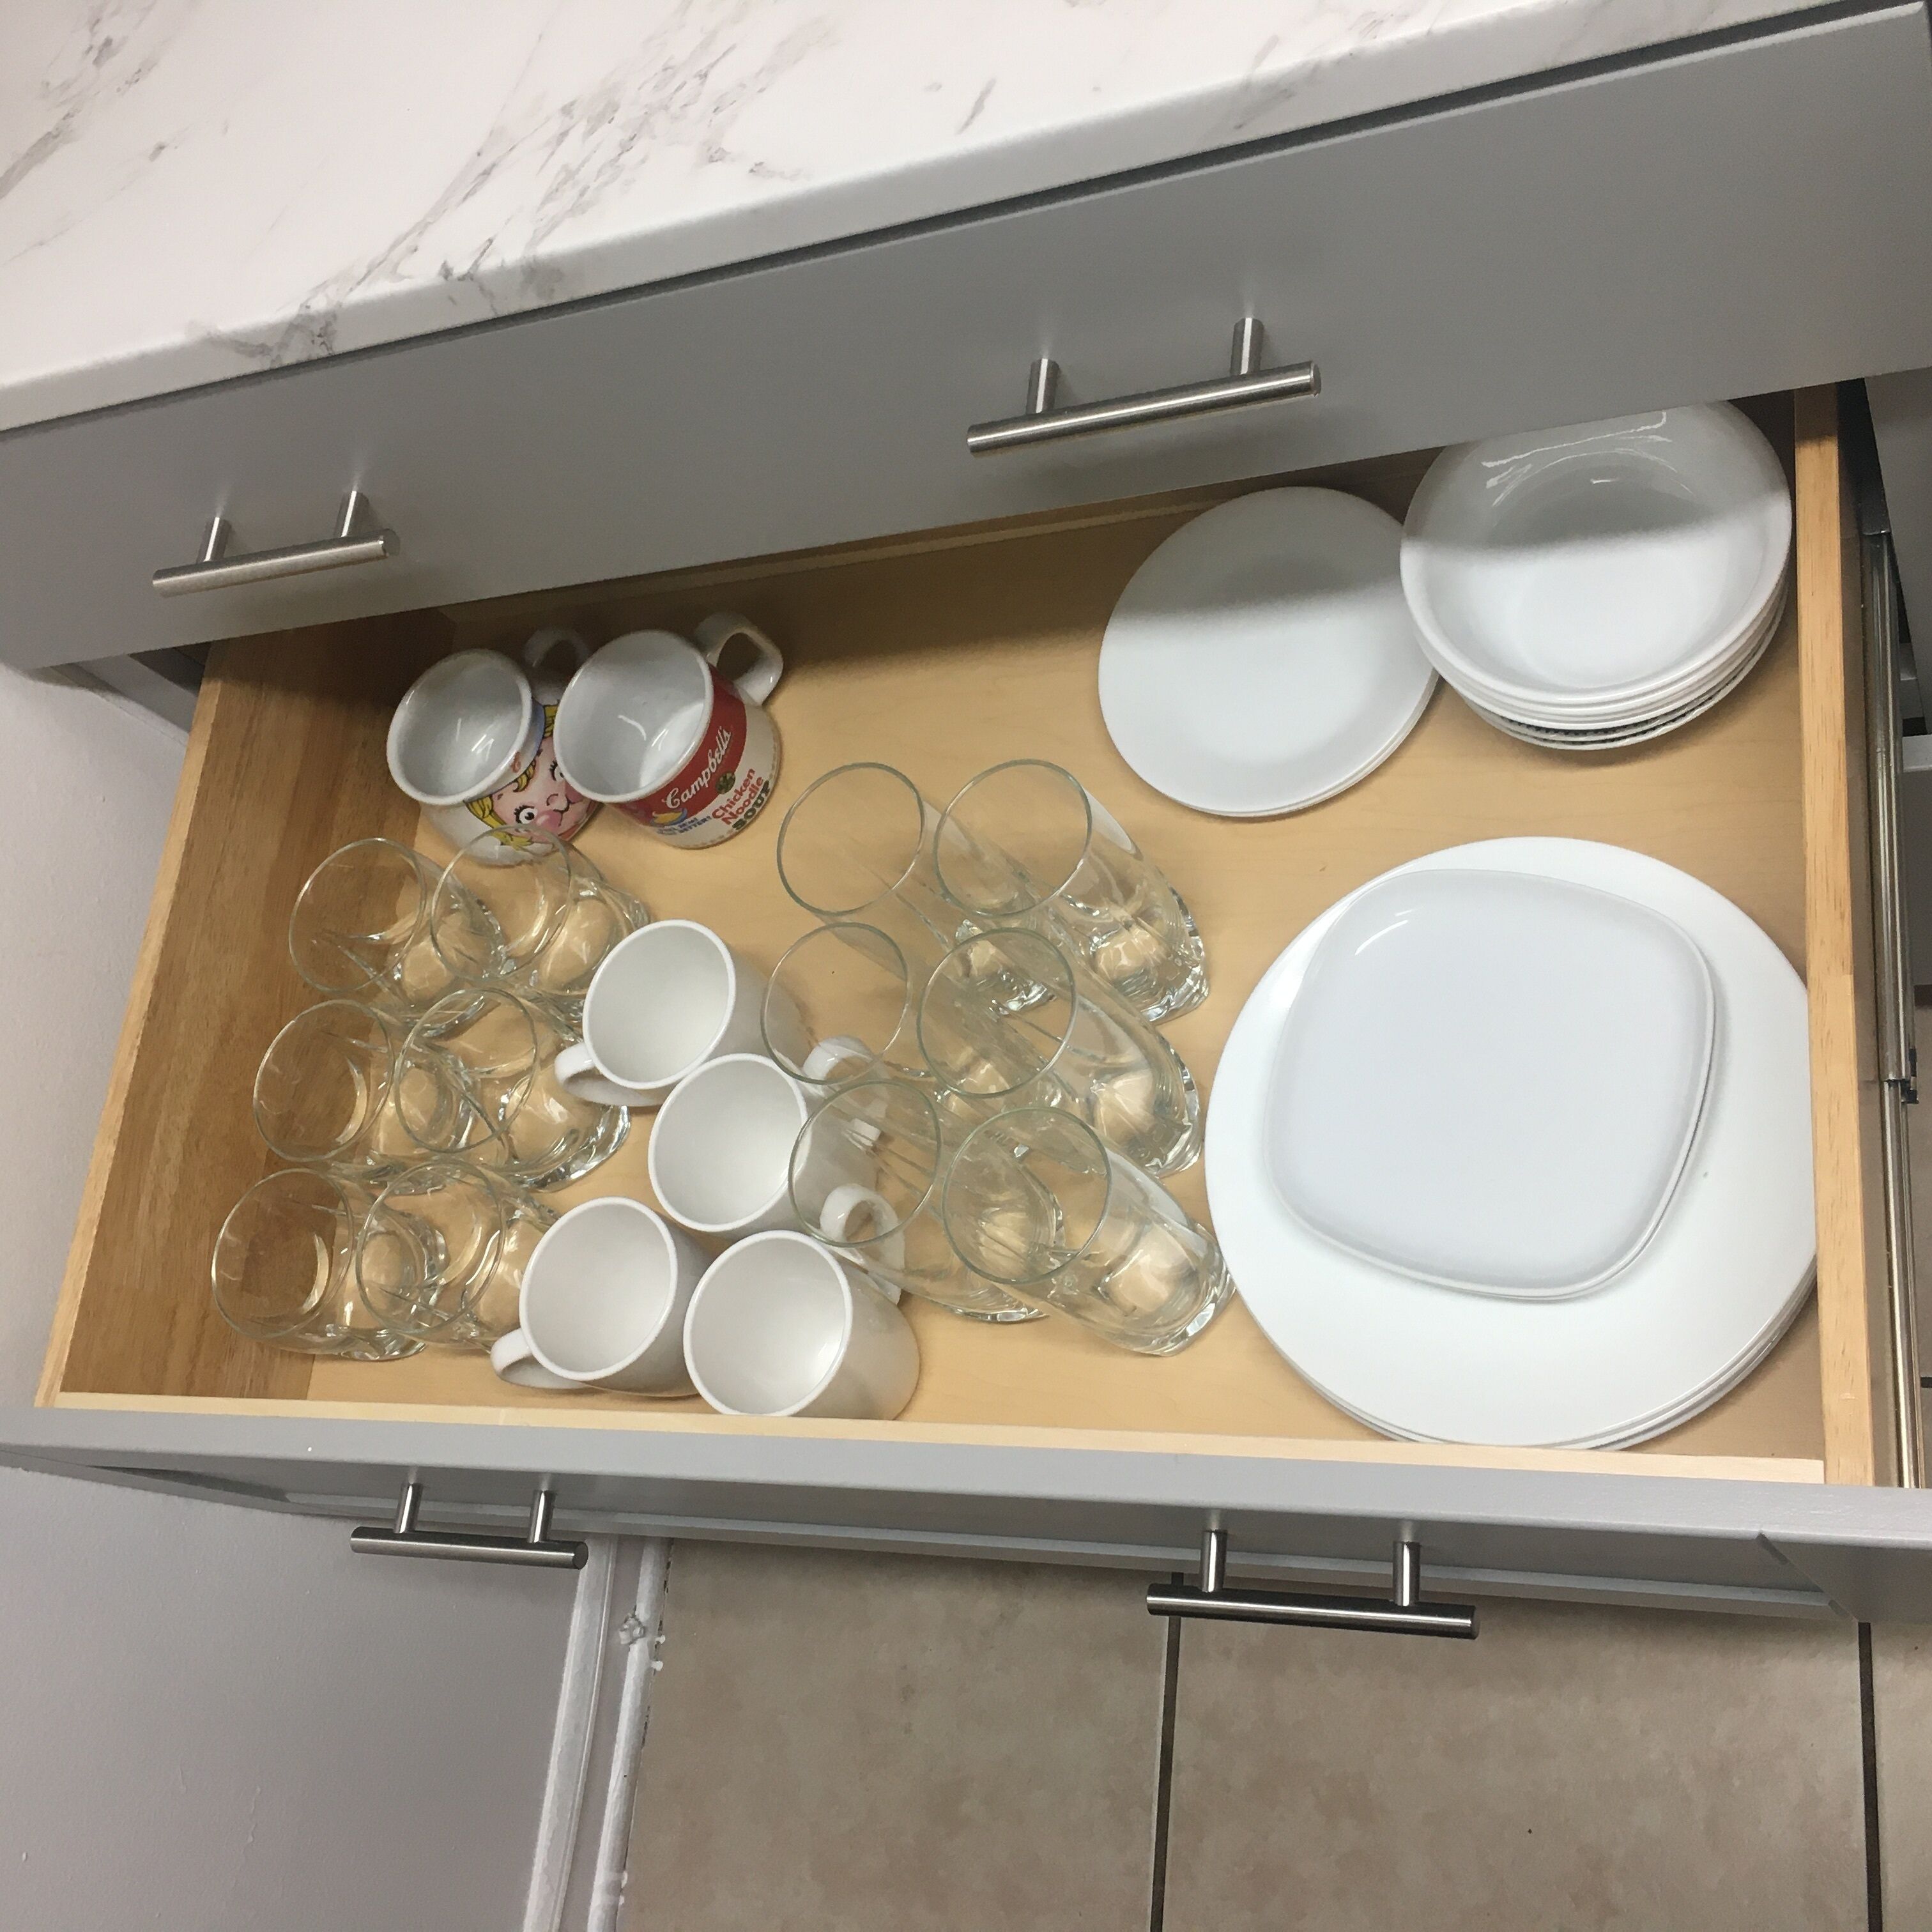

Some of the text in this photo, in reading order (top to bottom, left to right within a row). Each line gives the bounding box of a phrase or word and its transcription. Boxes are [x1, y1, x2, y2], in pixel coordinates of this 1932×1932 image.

[661, 726, 731, 809] Campbell's
[712, 769, 755, 818] Chicken
[721, 777, 763, 825] Noodle
[732, 780, 770, 830] SOUP
